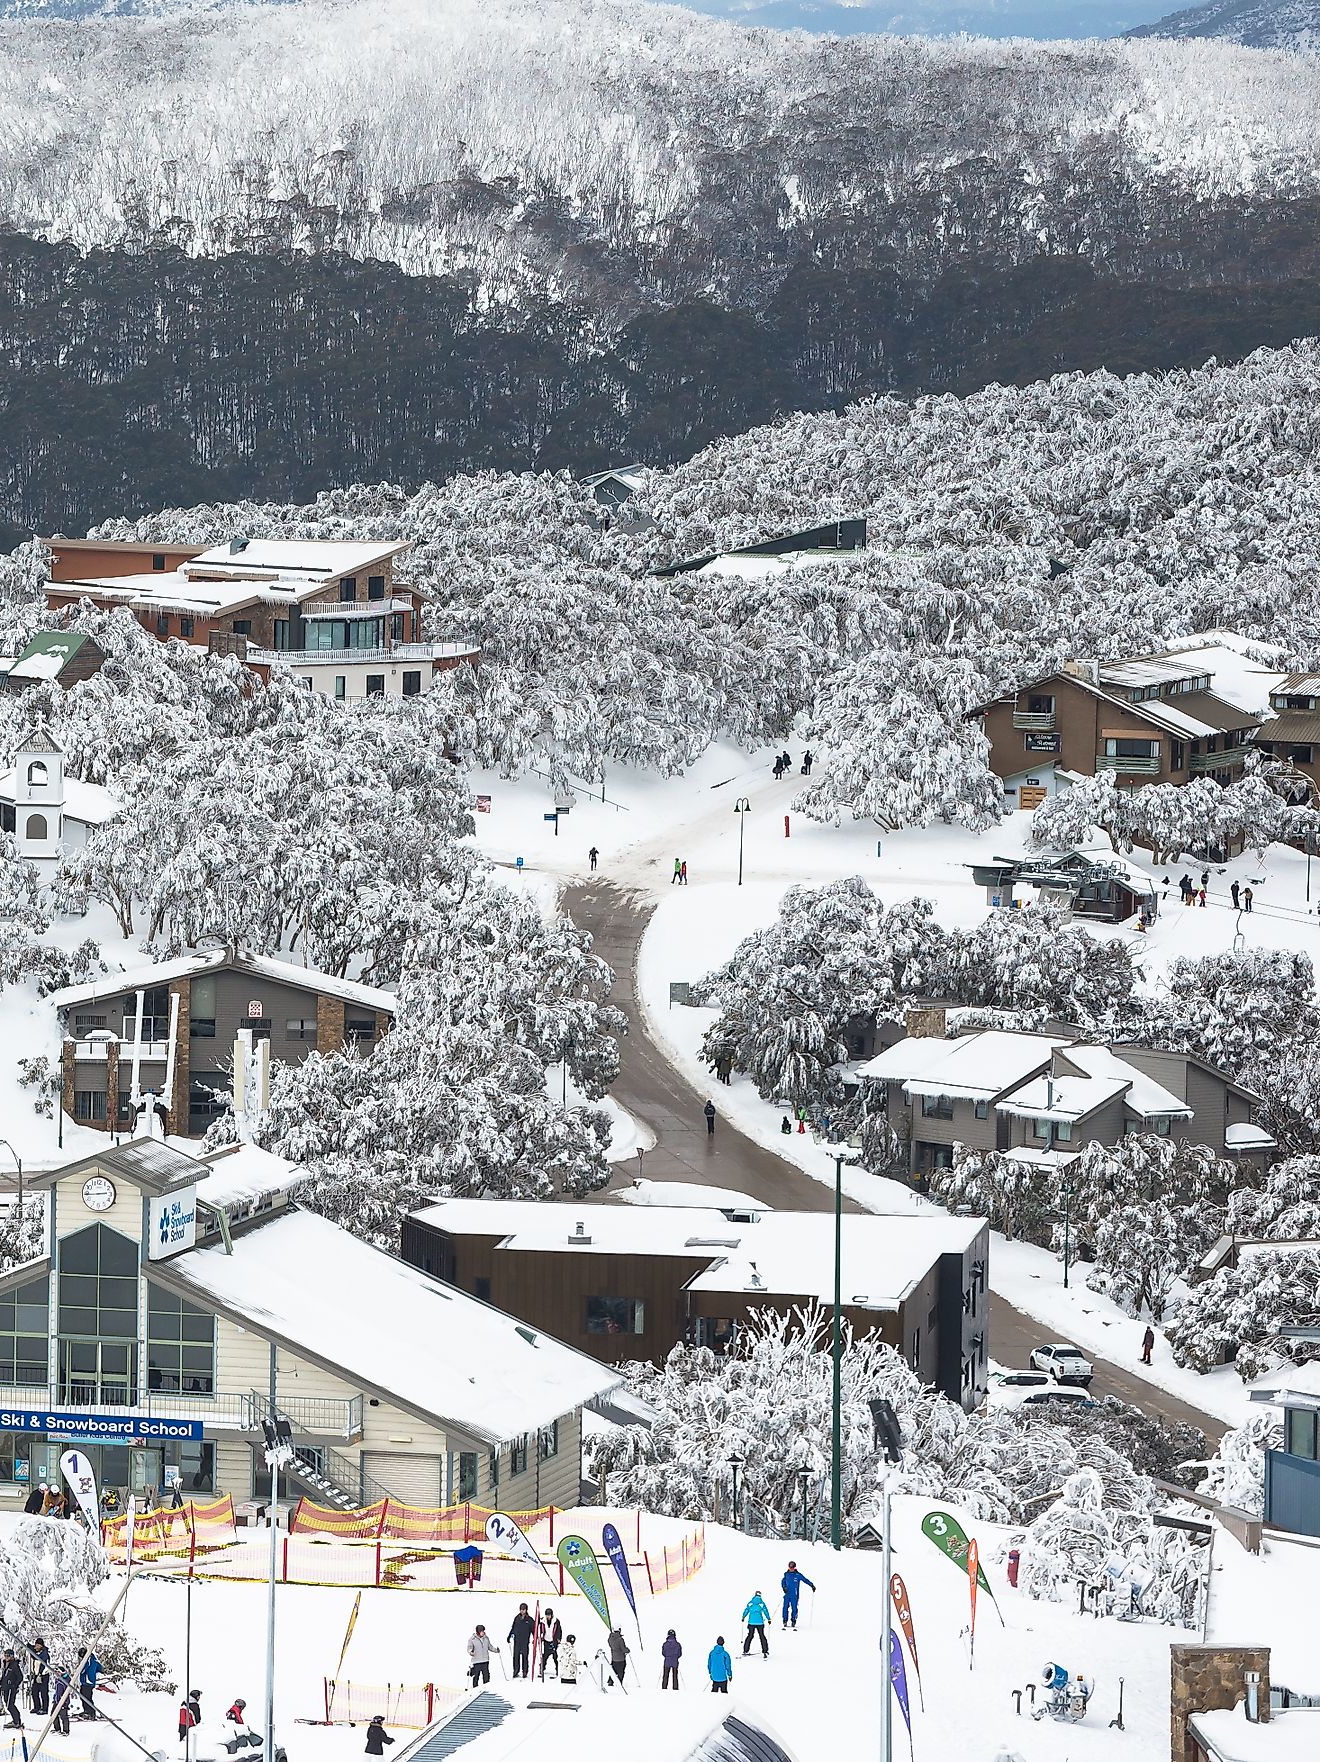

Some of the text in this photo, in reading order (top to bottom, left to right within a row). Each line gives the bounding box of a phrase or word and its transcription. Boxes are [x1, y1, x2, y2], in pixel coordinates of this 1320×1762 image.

[0, 1413, 192, 1437] Ski & Snowboard School
[67, 1453, 79, 1474] 1
[490, 1517, 505, 1539] 2
[929, 1515, 948, 1536] 3
[568, 1556, 594, 1569] Adult
[892, 1577, 902, 1600] 5
